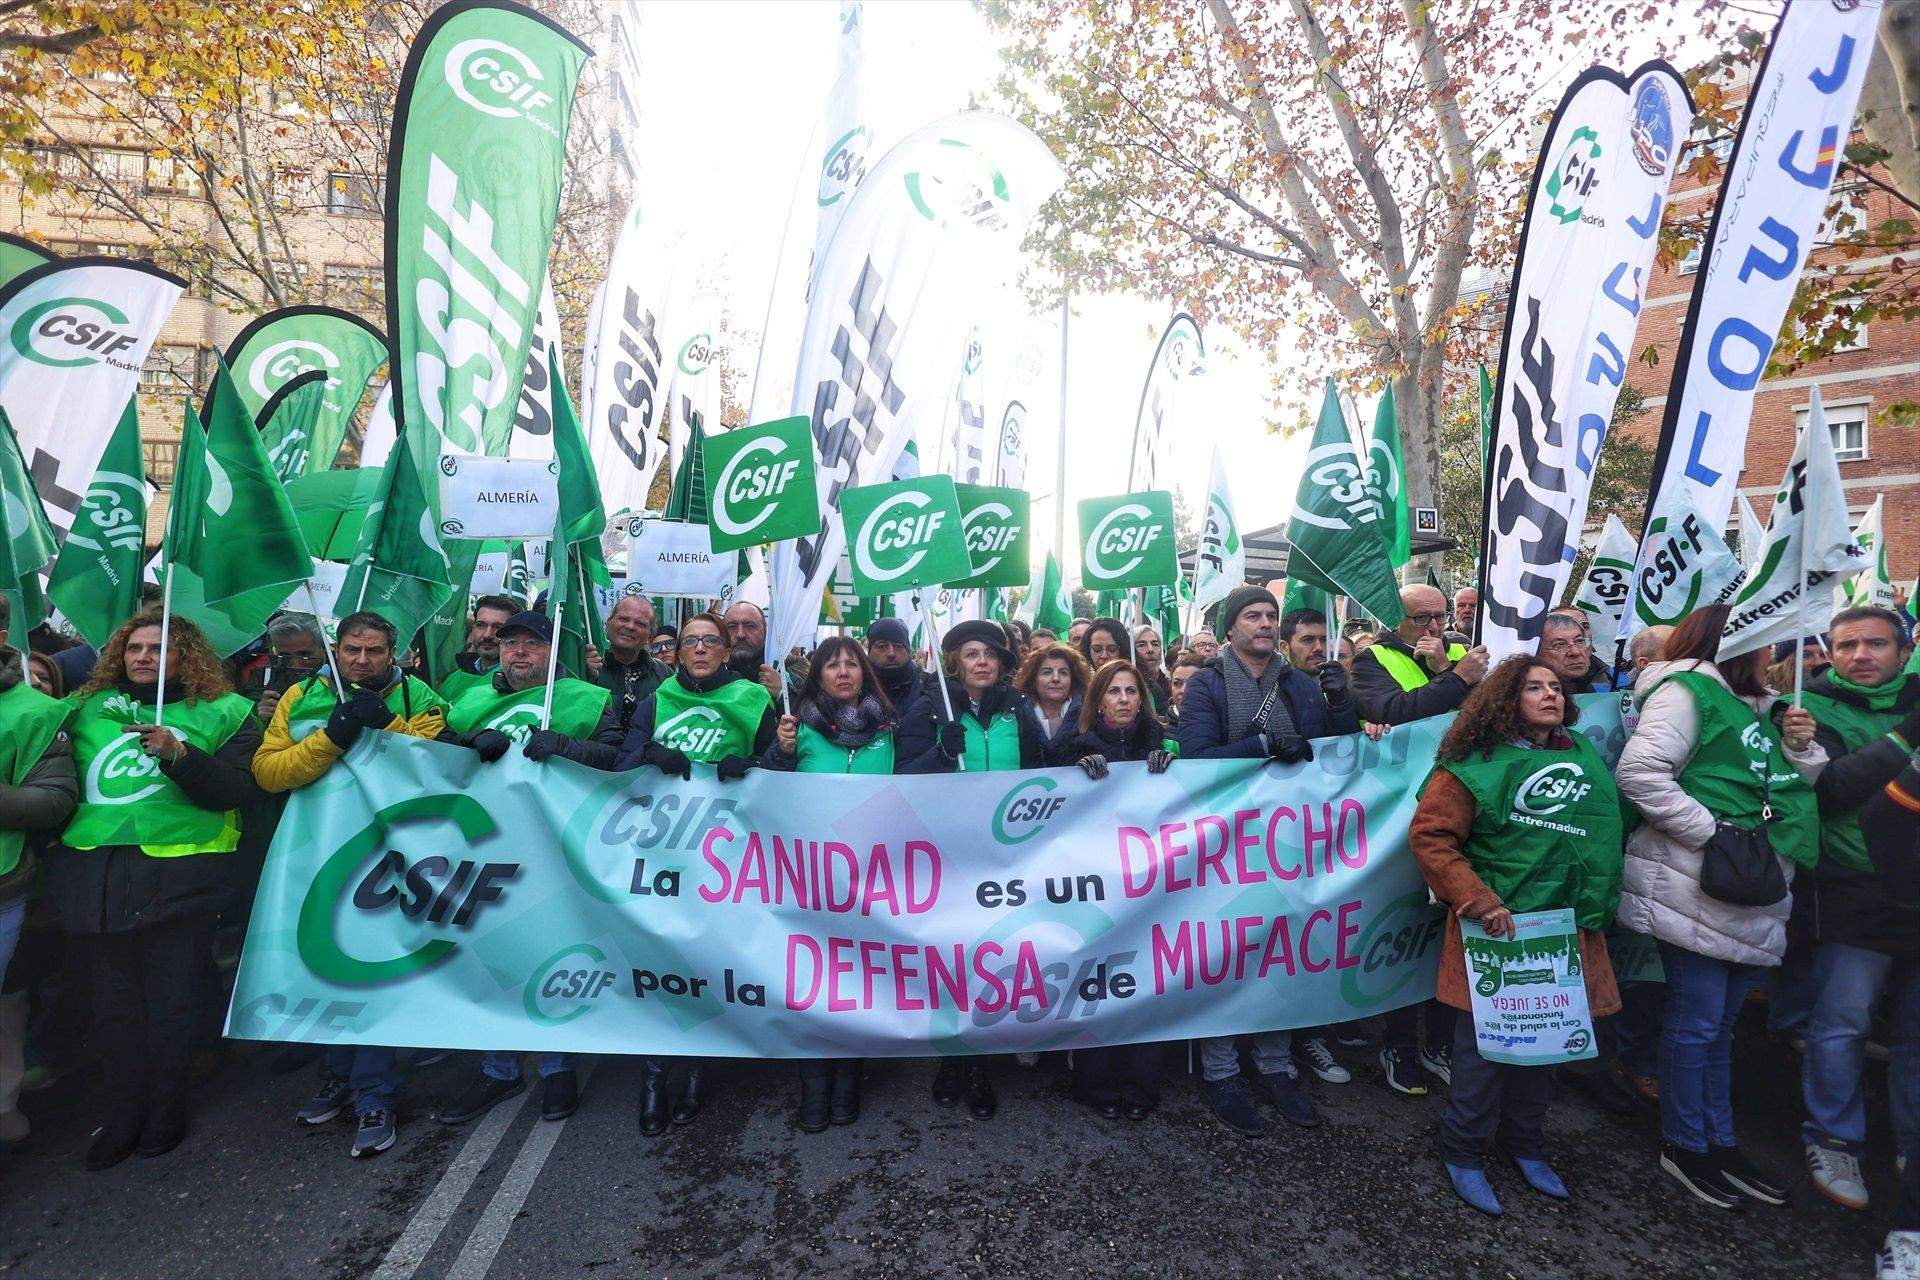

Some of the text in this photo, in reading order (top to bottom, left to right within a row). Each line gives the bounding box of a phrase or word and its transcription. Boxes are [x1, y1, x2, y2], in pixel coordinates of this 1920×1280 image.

[468, 57, 555, 110] CSIF
[525, 111, 560, 139] Madrid
[416, 152, 532, 458] CSIF
[38, 315, 138, 355] CSIF
[688, 344, 720, 366] CSIF
[608, 285, 662, 471] CSIF
[729, 459, 799, 504] CSIF
[477, 490, 539, 504] ALMERÍA
[82, 489, 142, 552] CSIF
[874, 511, 946, 552] CSIF
[966, 526, 1021, 551] CSIF
[1101, 525, 1163, 555] CSIF
[98, 555, 120, 587] Madrid
[658, 552, 710, 565] ALMERÍA
[668, 727, 728, 754] CSIF
[1006, 797, 1066, 823] CSIF
[1508, 812, 1587, 837] Extremadura
[629, 798, 1369, 916] La SANIDAD es un DERECHO
[353, 849, 521, 926] CSIF
[631, 900, 1362, 1014] por la DEFENSA de MUFACE
[1364, 916, 1447, 974] CSIF
[542, 969, 616, 999] CSIF
[1491, 994, 1569, 1011] NO SE JUEGA
[1501, 1011, 1564, 1020] funcionari@s
[1504, 1023, 1517, 1032] de
[1521, 1022, 1548, 1032] salud
[1551, 1020, 1560, 1029] la
[1564, 1019, 1581, 1028] Con
[1563, 1035, 1585, 1049] CSIF
